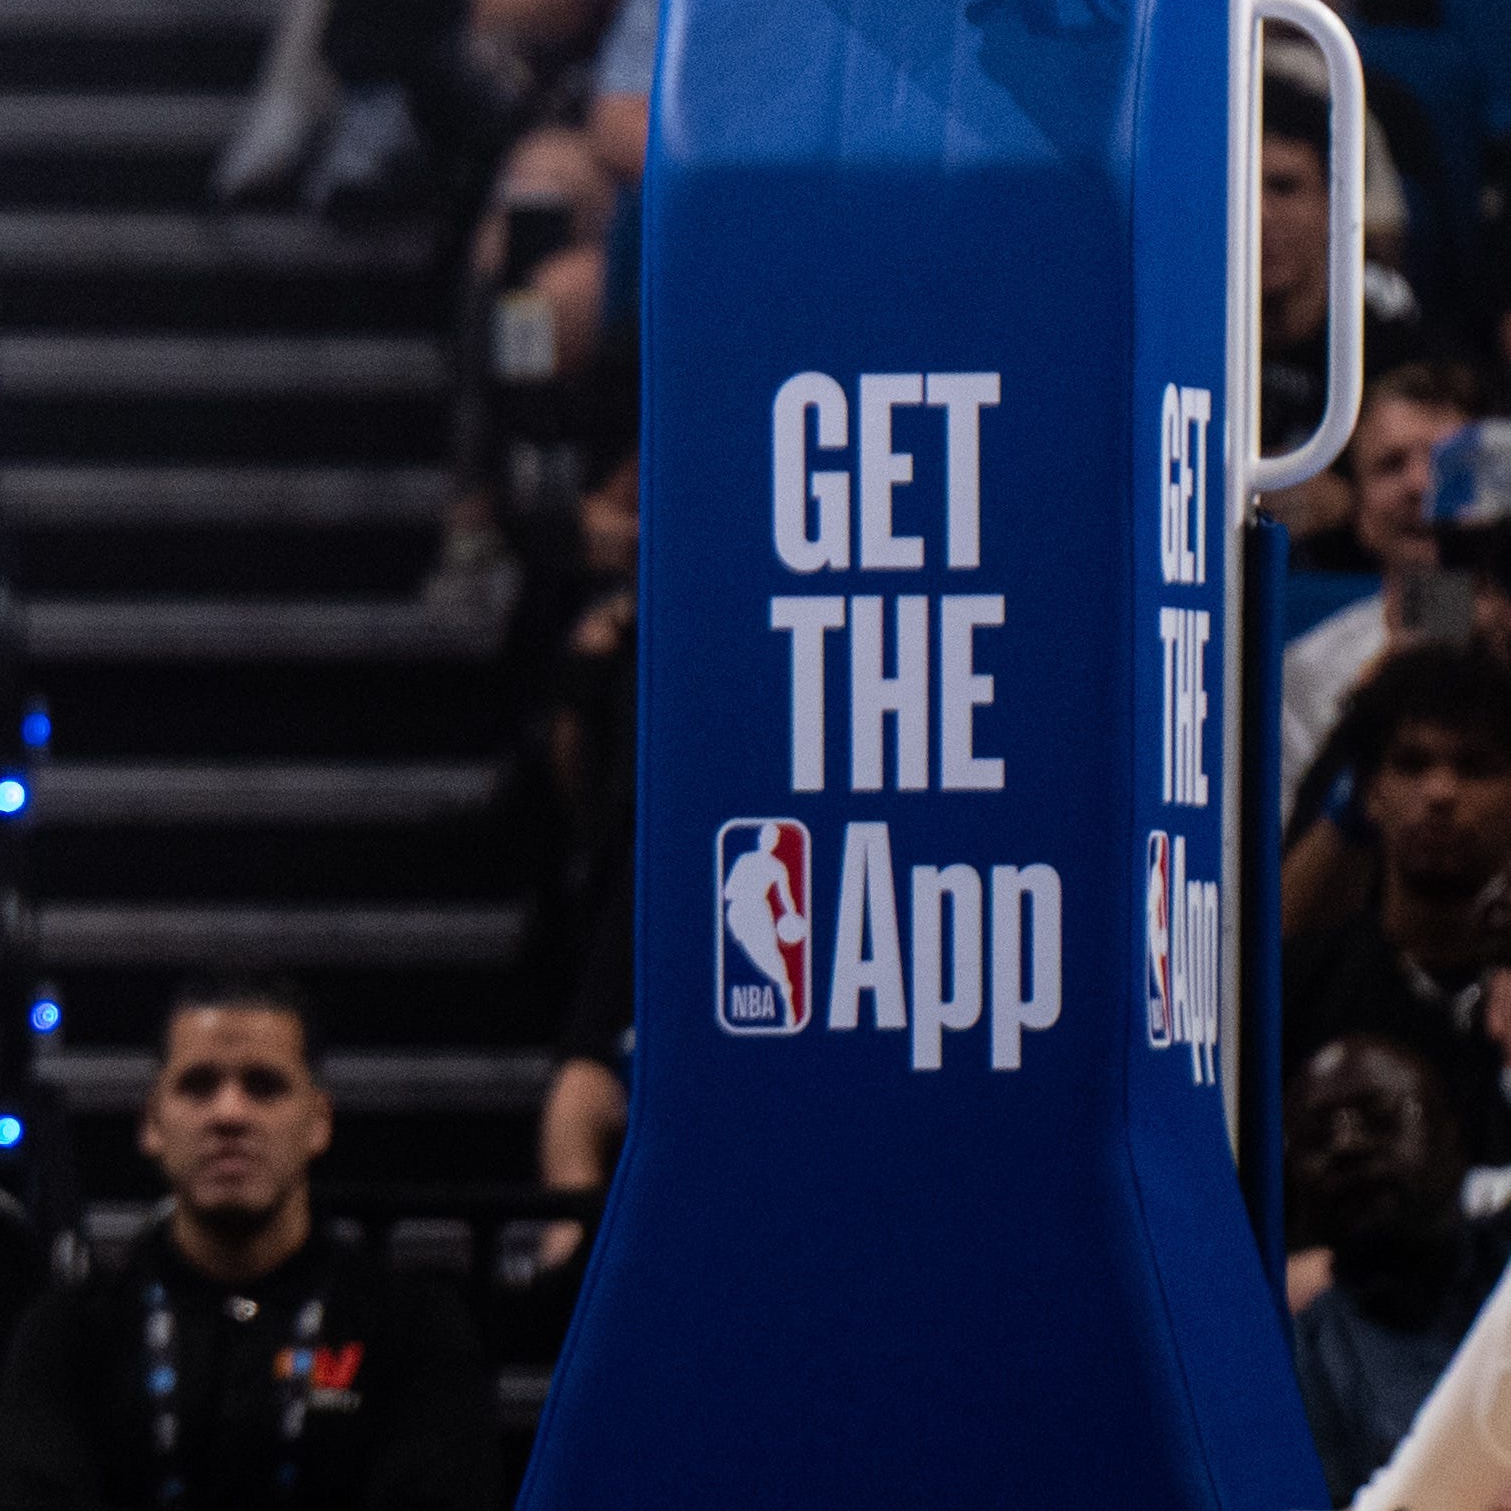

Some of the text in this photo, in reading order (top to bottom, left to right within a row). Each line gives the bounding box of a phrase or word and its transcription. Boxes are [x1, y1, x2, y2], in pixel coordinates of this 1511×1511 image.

[771, 370, 1001, 574] GET
[1160, 382, 1211, 584] GET
[771, 595, 1005, 793] THE
[1160, 607, 1210, 807] THE
[731, 821, 1063, 1071] NBA App
[1172, 834, 1219, 1085] App
